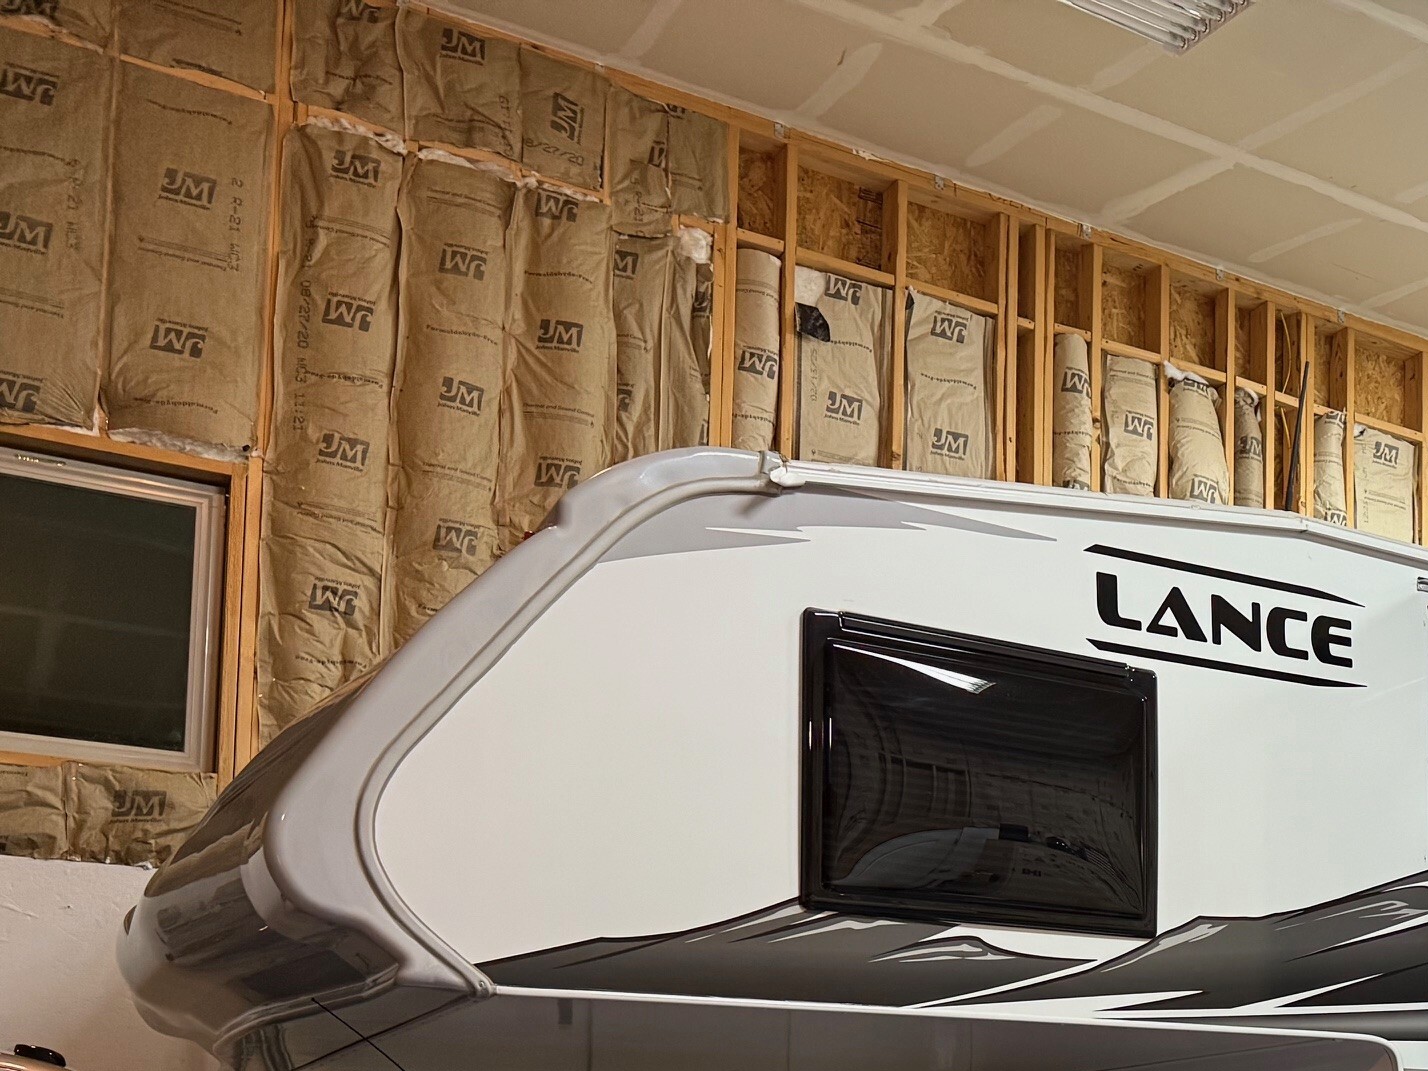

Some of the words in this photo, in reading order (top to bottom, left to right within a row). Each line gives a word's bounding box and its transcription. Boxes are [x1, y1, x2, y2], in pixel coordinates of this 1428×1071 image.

[441, 28, 486, 61] JM
[0, 67, 58, 106] JM
[550, 92, 580, 141] JM
[331, 149, 381, 183] JM
[160, 167, 217, 205] JM
[228, 197, 243, 232] R-21
[535, 192, 579, 223] JM
[438, 248, 487, 281] JM
[614, 251, 638, 275] M
[825, 273, 862, 306] JM
[298, 281, 311, 349] 08/27/20
[322, 298, 374, 332] JM
[931, 315, 967, 344] JM
[149, 324, 206, 358] JM
[538, 319, 584, 348] JM
[738, 351, 778, 380] JM
[920, 372, 977, 390] Formaldehyde-Free
[440, 376, 484, 411] JM
[826, 391, 863, 421] JM
[931, 428, 969, 456] JM
[1124, 414, 1154, 441] JM
[319, 433, 370, 466] JM
[1373, 441, 1400, 465] JM
[534, 462, 580, 490] JM
[1190, 479, 1219, 504] JM
[433, 524, 478, 556] JM
[308, 583, 358, 616] JM
[1096, 571, 1353, 668] LANCE
[111, 790, 167, 817] JM
